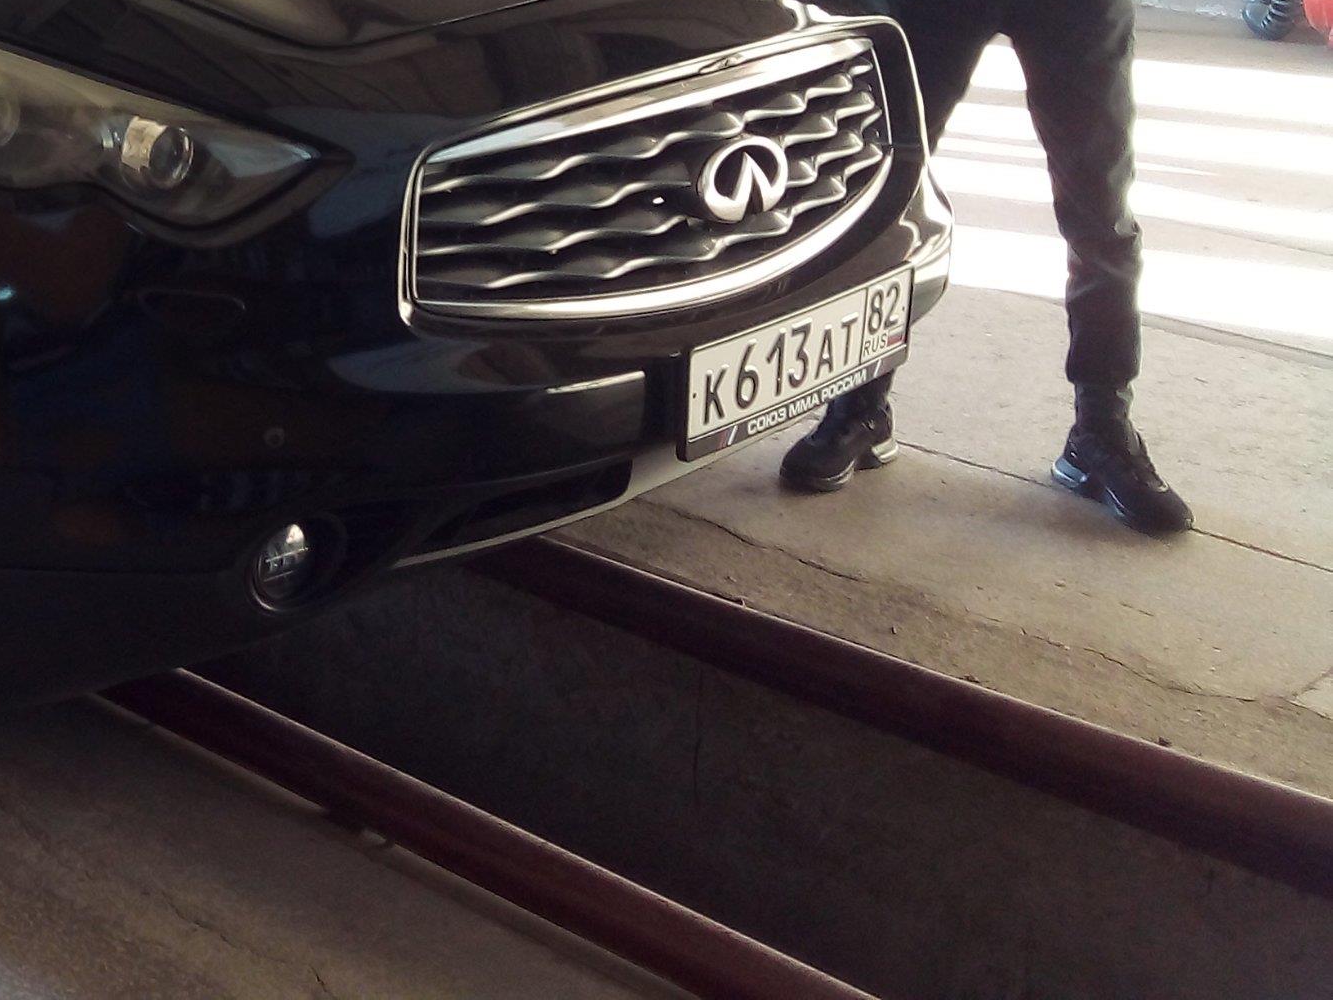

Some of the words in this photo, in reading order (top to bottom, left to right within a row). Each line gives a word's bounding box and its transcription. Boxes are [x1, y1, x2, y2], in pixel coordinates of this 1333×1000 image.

[867, 281, 901, 335] 82
[863, 333, 888, 359] RUS
[746, 408, 788, 436] СОЮЗ
[787, 393, 821, 419] ММА
[820, 368, 867, 403] РОССИИ
